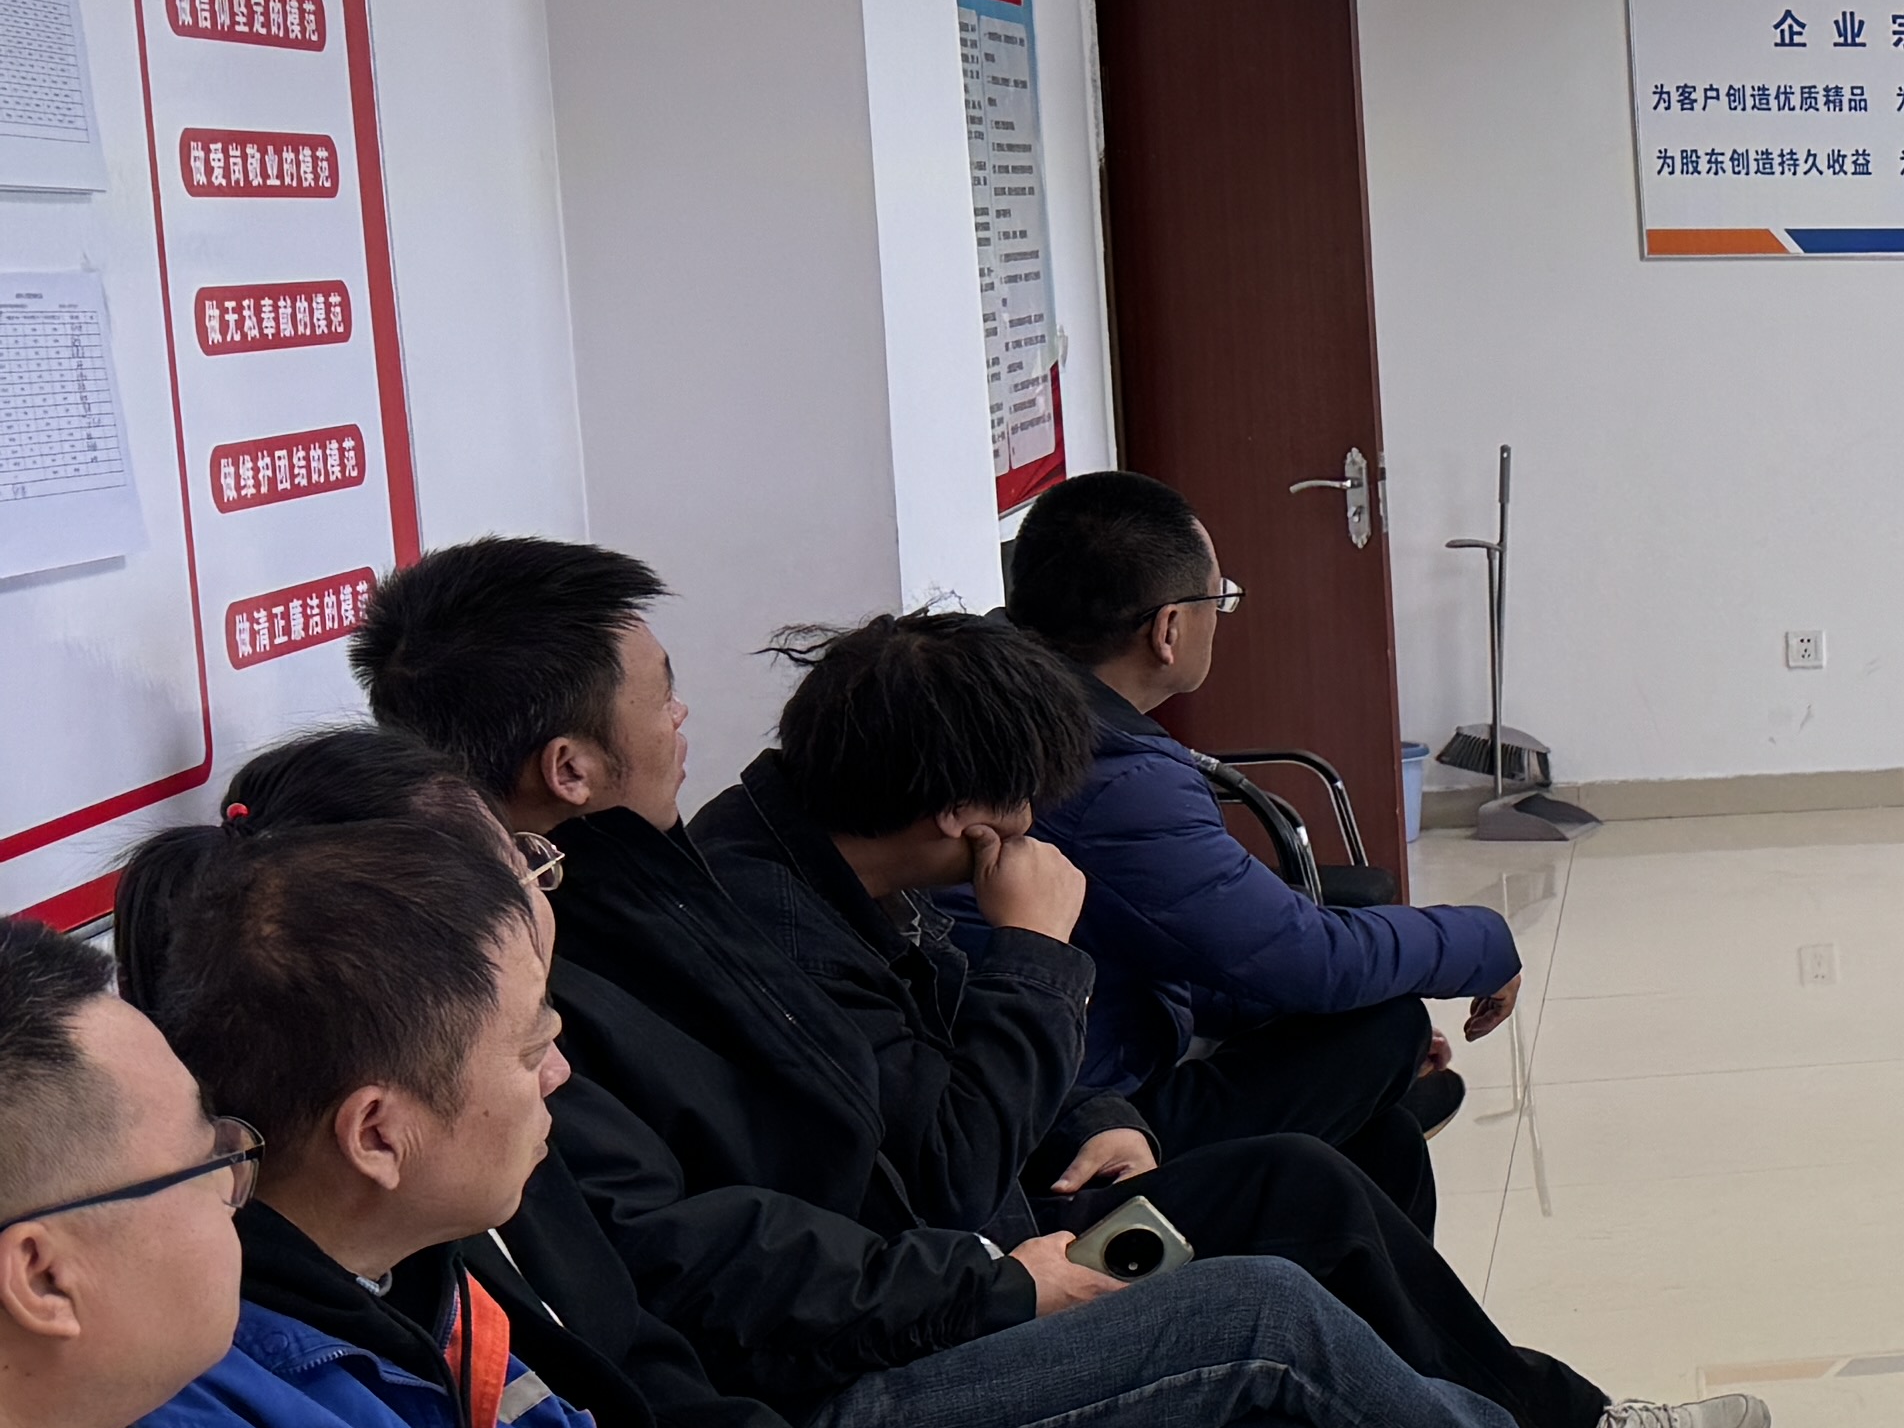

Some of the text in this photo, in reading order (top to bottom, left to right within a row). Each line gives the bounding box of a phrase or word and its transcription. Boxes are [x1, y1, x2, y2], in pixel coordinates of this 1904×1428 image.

[1651, 82, 1869, 113] 为客户创造优质精品
[189, 140, 332, 188] 做爱岗敬业的模范
[1656, 147, 1873, 177] 为股东创造持久收益
[204, 291, 345, 345] 做无私奉献的模范
[219, 436, 359, 503] 做维护团结的模范
